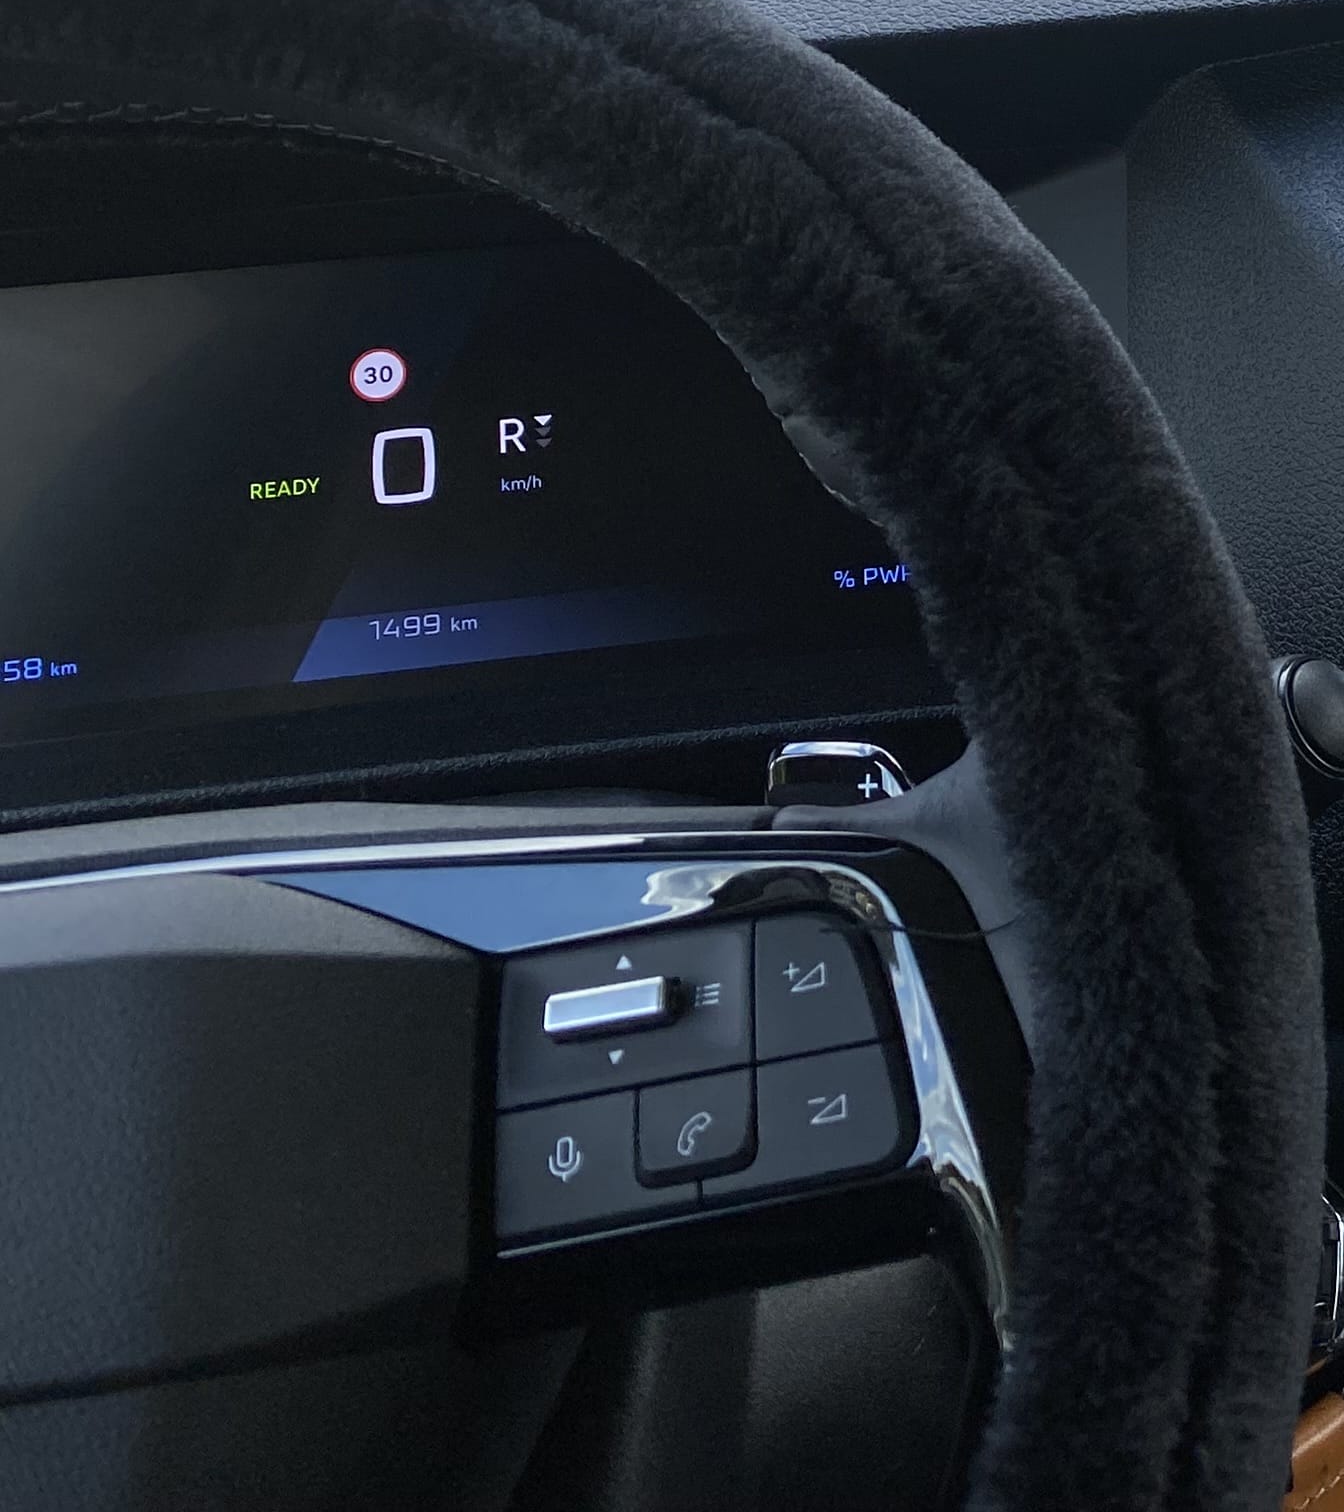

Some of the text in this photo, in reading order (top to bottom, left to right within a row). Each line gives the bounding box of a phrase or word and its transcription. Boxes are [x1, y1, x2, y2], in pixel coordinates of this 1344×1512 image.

[364, 365, 393, 384] 30
[499, 418, 526, 454] R
[372, 427, 435, 505] 0
[250, 477, 320, 500] READY
[501, 475, 542, 492] km/h
[834, 570, 855, 588] %
[369, 614, 478, 640] 1499 km
[3, 657, 77, 682] 58 km
